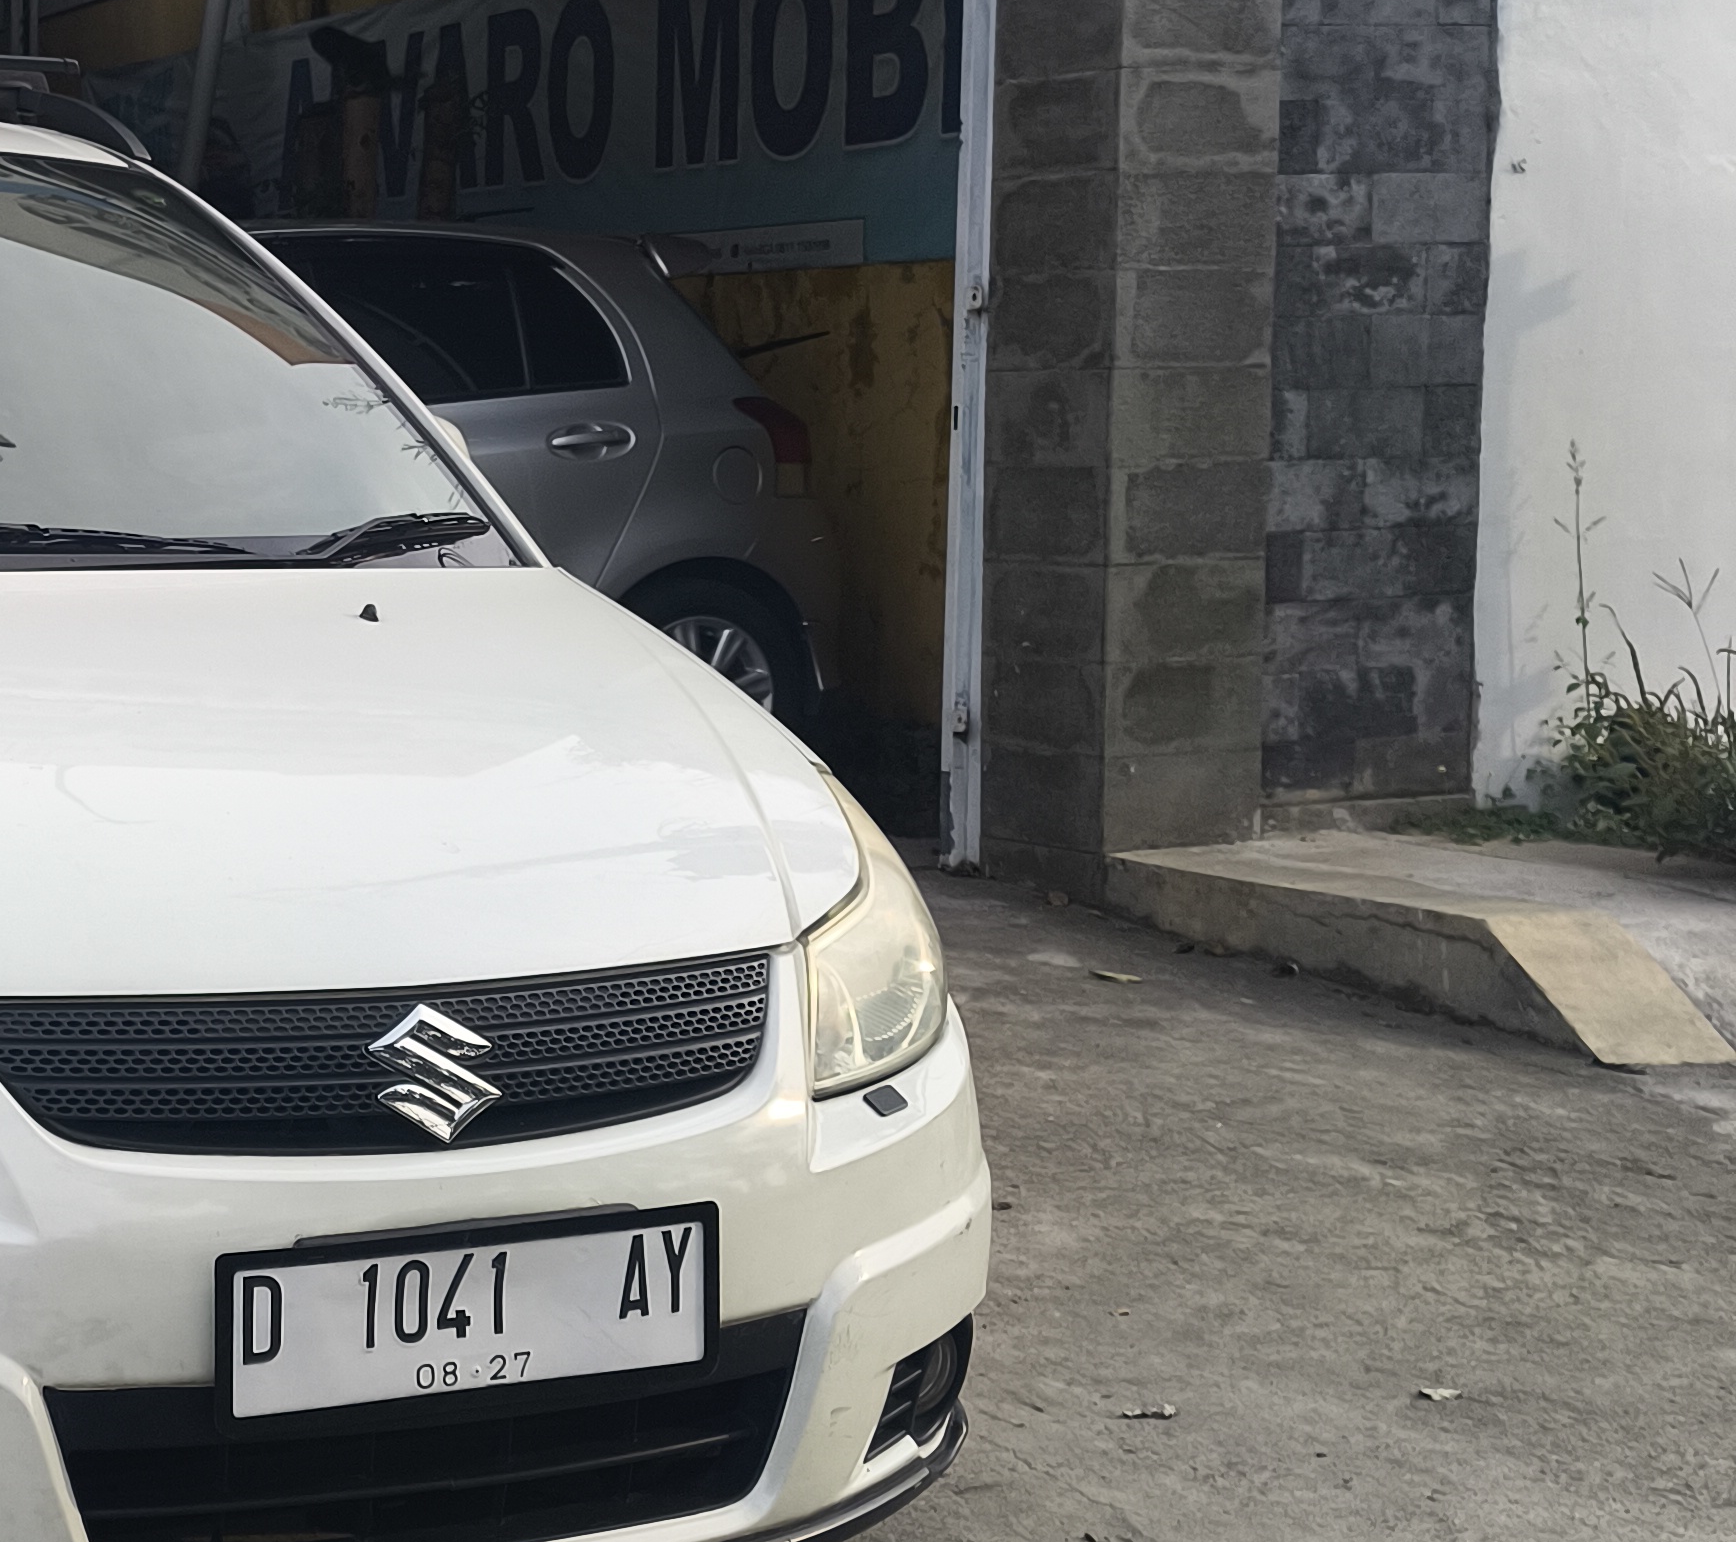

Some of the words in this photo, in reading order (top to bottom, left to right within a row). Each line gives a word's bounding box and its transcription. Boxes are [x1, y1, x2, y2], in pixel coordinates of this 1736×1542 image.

[242, 1275, 282, 1366] D
[361, 1251, 509, 1349] 1041
[618, 1226, 694, 1320] AY
